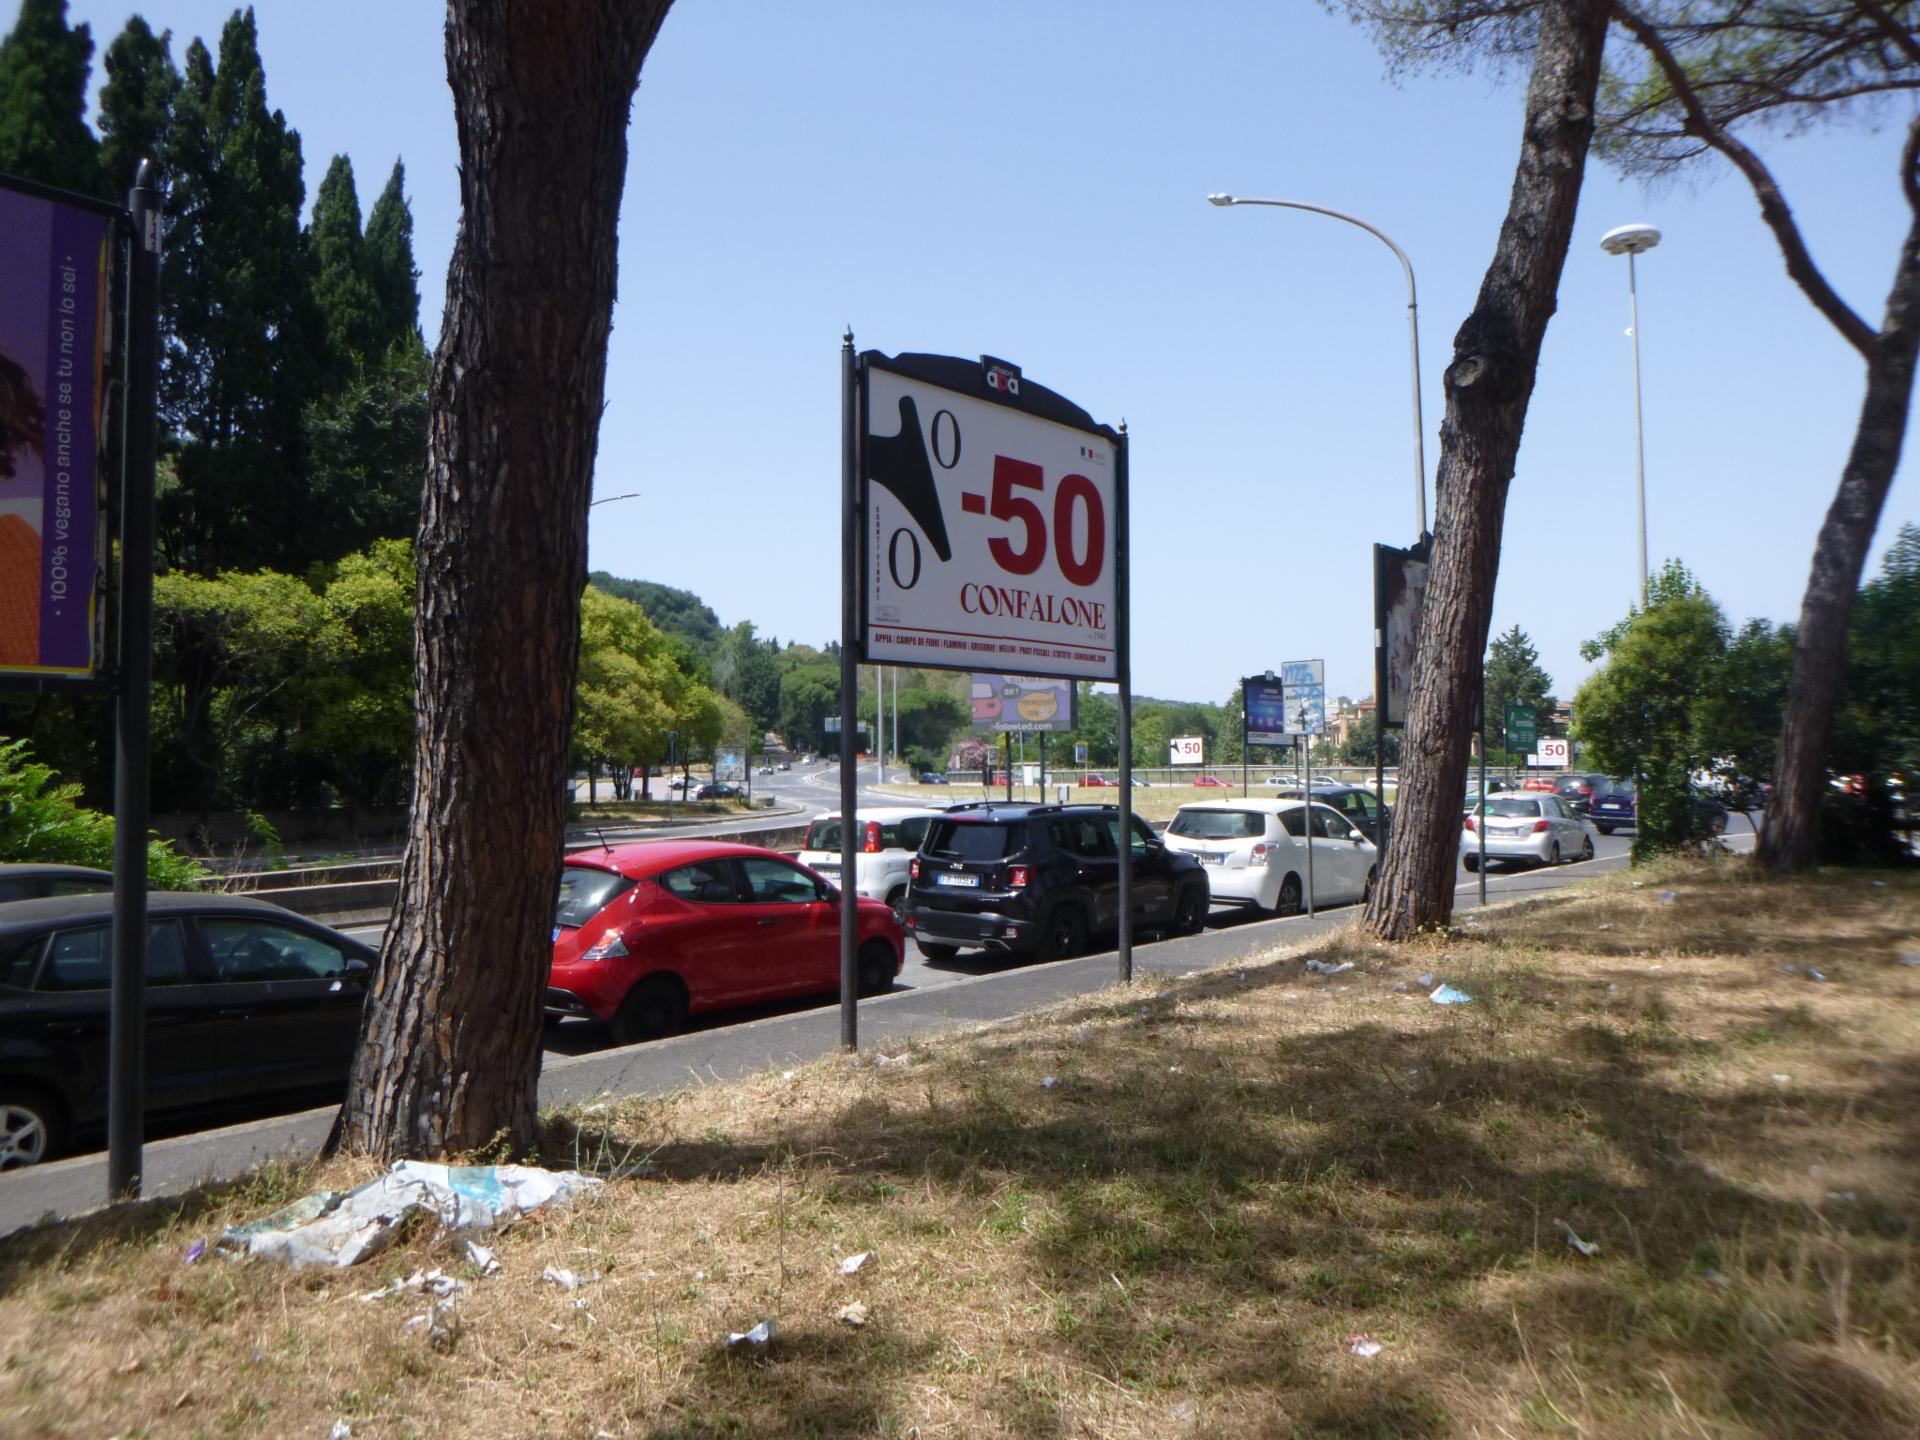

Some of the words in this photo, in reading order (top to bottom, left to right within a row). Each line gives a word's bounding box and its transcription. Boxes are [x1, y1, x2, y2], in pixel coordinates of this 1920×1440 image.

[61, 265, 76, 293] sei
[59, 298, 75, 314] lo
[61, 319, 75, 354] non
[57, 358, 73, 377] tu
[59, 383, 72, 404] se
[56, 409, 72, 467] anche
[55, 471, 71, 540] vegano
[962, 454, 1105, 586] -50
[51, 545, 68, 602] 100%
[960, 583, 1106, 629] CONFALONE
[875, 633, 892, 644] APPIA
[896, 635, 916, 645] CAMPO
[925, 638, 940, 648] FIORI
